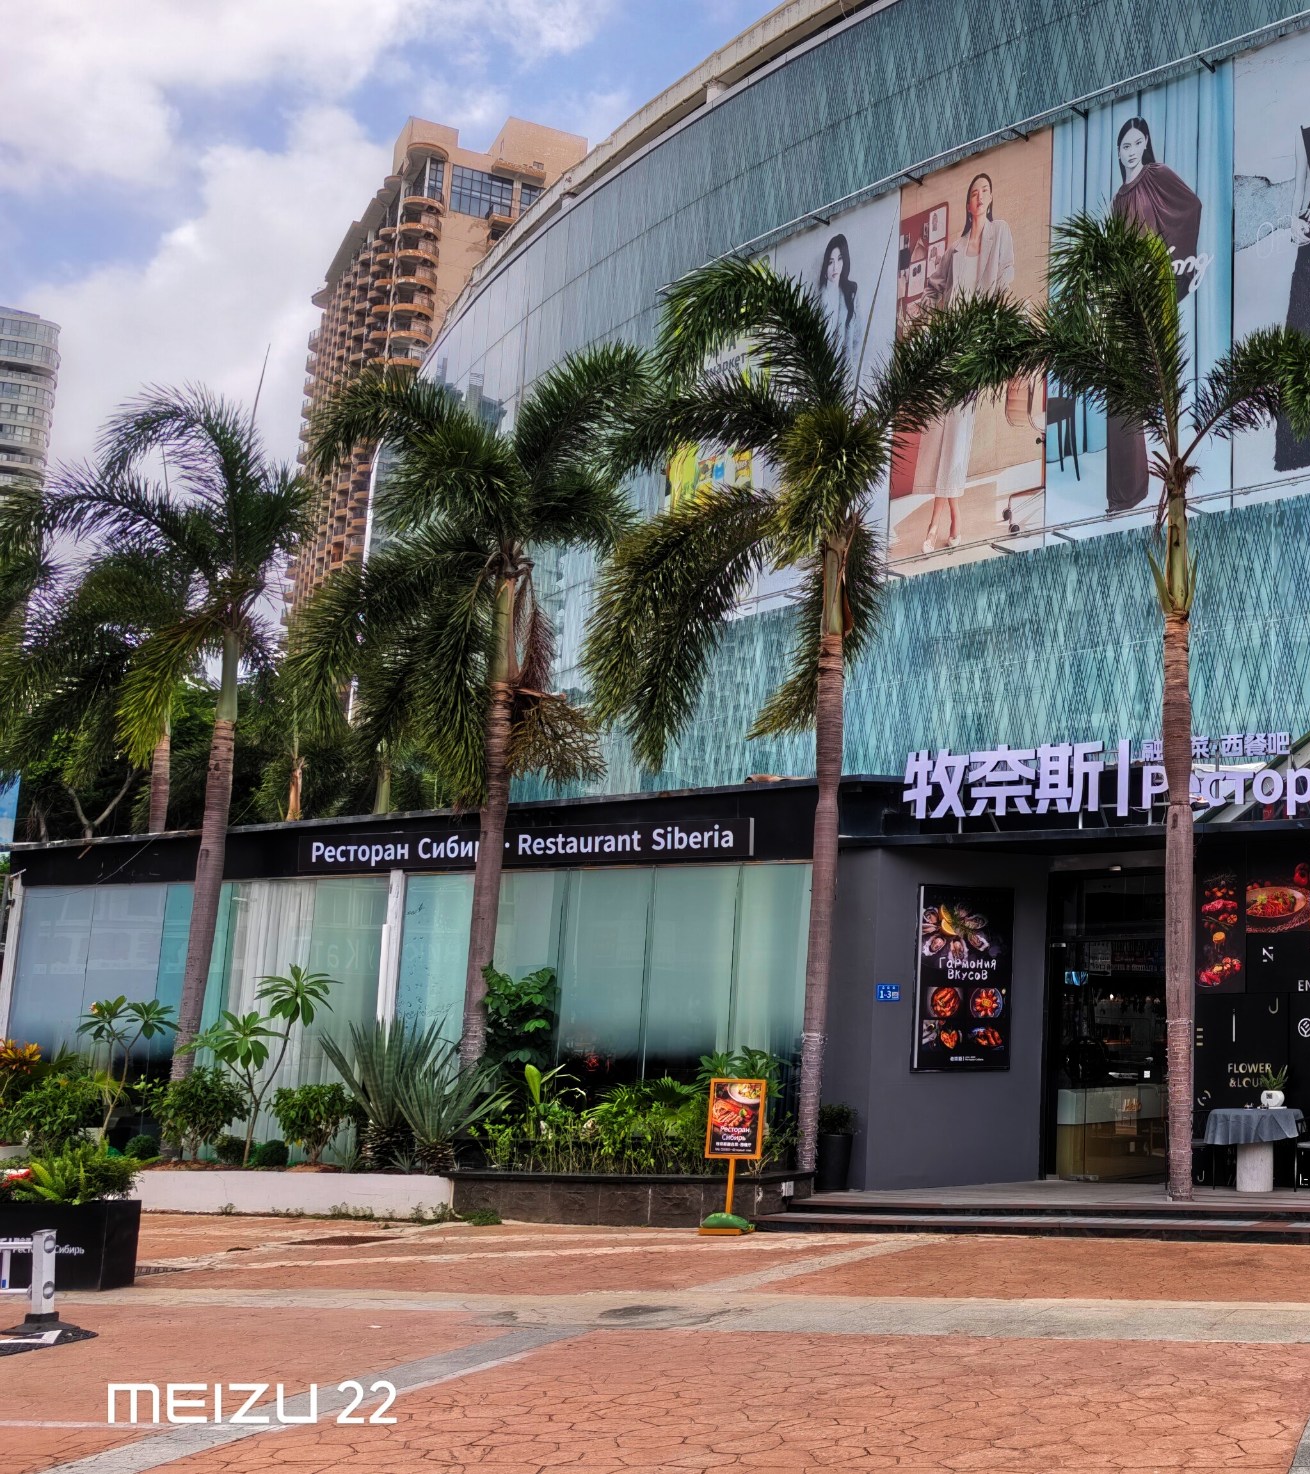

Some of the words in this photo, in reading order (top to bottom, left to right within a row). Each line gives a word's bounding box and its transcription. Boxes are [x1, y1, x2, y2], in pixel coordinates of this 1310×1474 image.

[1142, 731, 1291, 762] 融菜·西餐吧
[903, 740, 1104, 820] 牧奈斯
[518, 830, 641, 855] Restaurant
[651, 824, 734, 850] Siberia
[311, 842, 409, 867] Ресторан
[1227, 1062, 1272, 1074] FLOWER
[1229, 1077, 1262, 1088] &LOU
[54, 1244, 85, 1256] Сибирь
